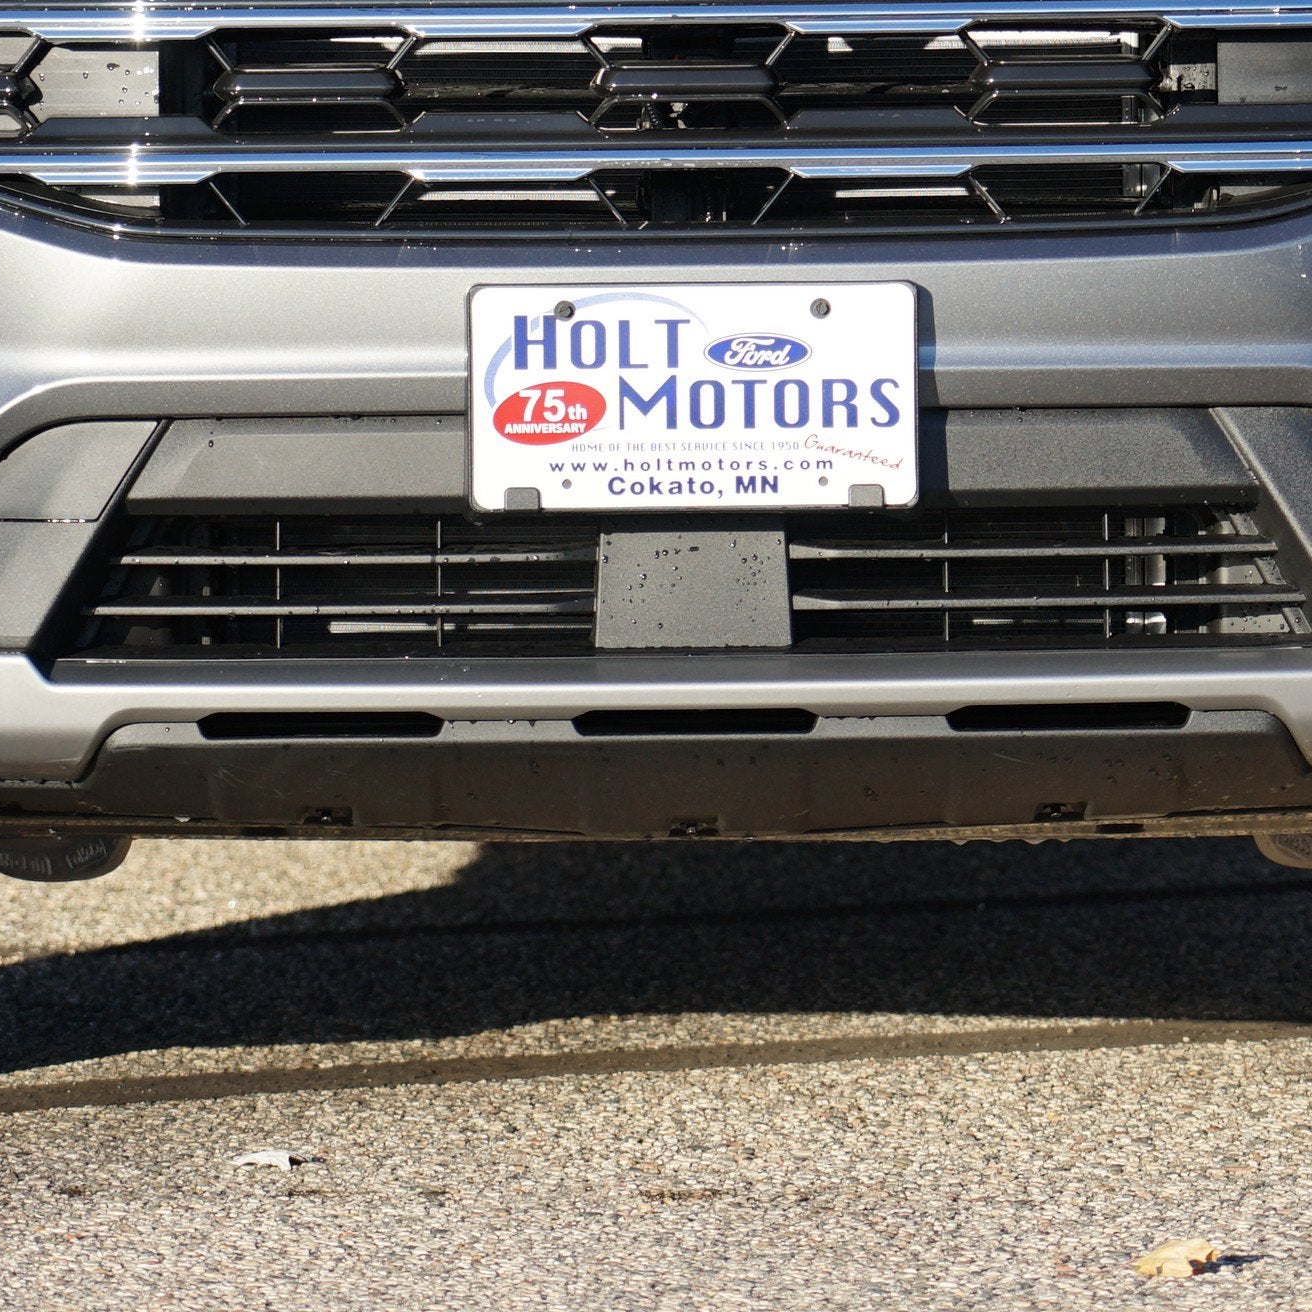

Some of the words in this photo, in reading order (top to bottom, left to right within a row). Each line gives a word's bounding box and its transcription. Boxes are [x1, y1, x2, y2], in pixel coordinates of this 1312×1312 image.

[514, 314, 691, 370] HOLT
[724, 337, 792, 366] Ford
[518, 388, 588, 423] 75th
[618, 374, 901, 430] MOTORS
[504, 422, 587, 435] ANNIVERSARY
[571, 443, 604, 453] HOME
[608, 442, 623, 452] OF
[626, 442, 647, 452] THE
[650, 442, 677, 452] BEST
[681, 441, 728, 452] SERVICE
[732, 441, 766, 451] SINCE
[771, 440, 800, 451] 1950
[804, 434, 904, 471] Guaranteed
[549, 457, 833, 472] www.holtmotors.com
[608, 475, 724, 498] Cokato,
[734, 475, 780, 495] MN
